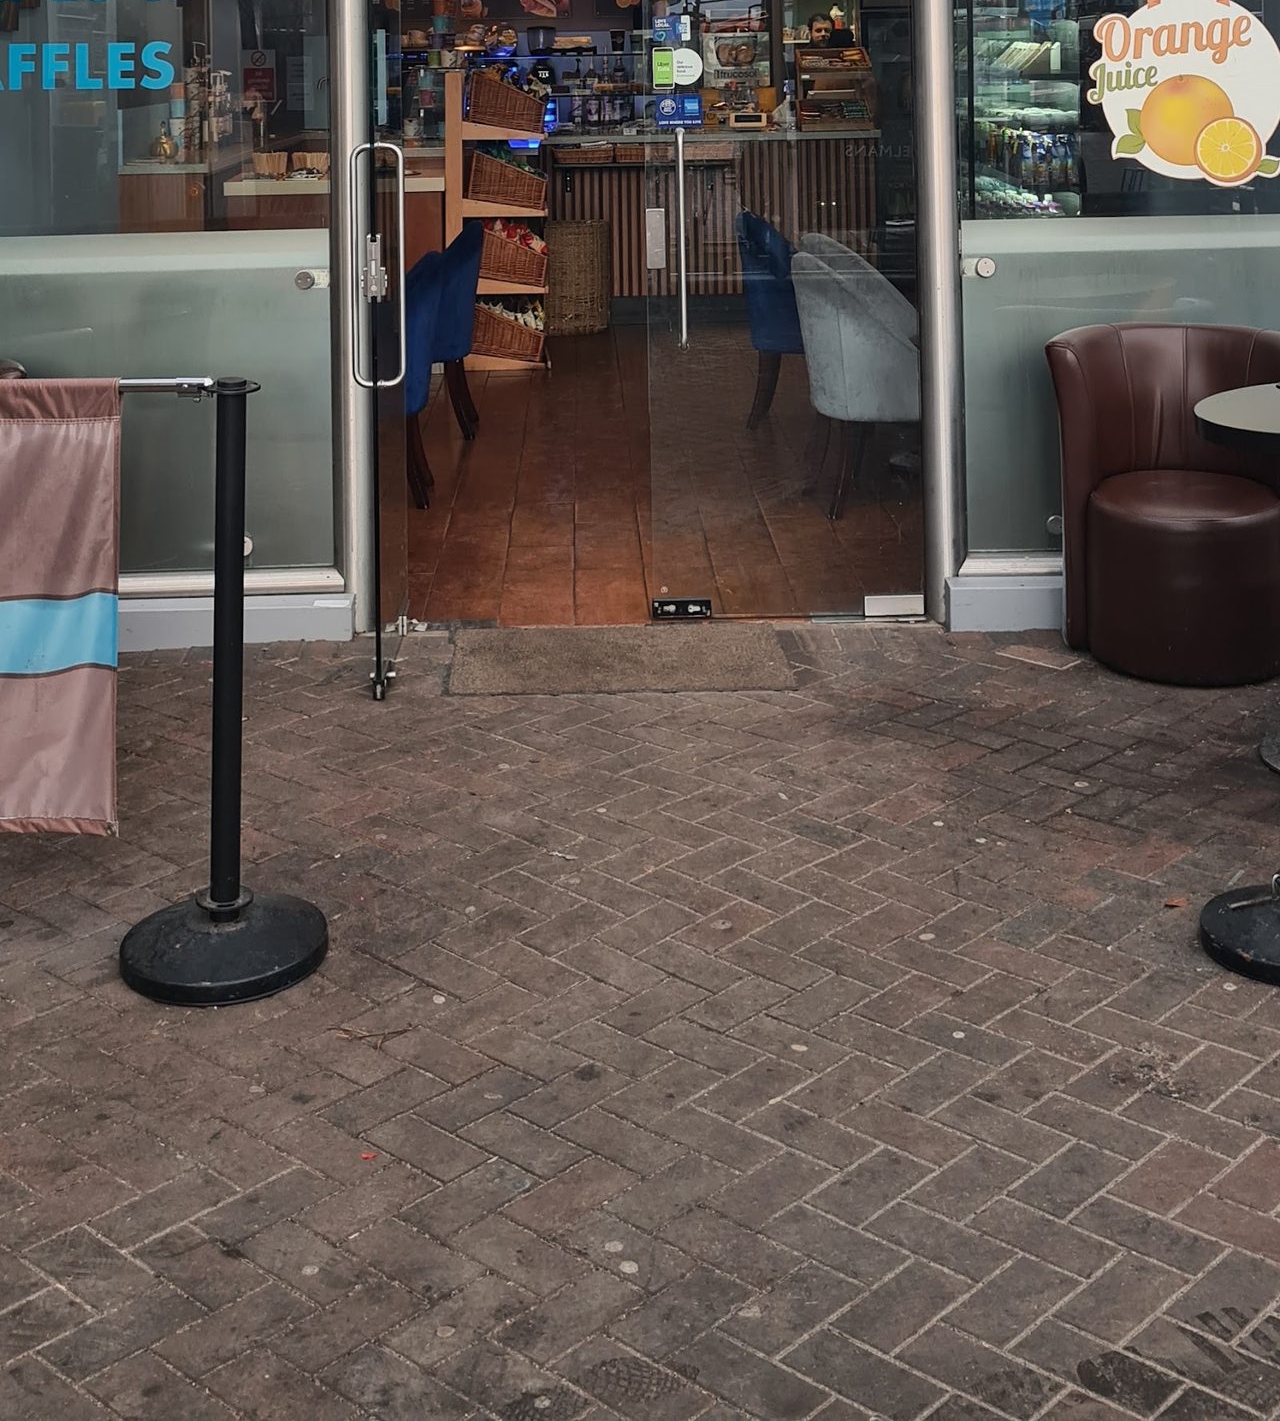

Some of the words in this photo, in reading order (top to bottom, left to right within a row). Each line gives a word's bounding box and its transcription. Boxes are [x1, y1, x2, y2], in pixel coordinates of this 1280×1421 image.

[1096, 15, 1252, 64] Orange
[0, 41, 175, 90] FFLES
[1089, 61, 1158, 102] Juice
